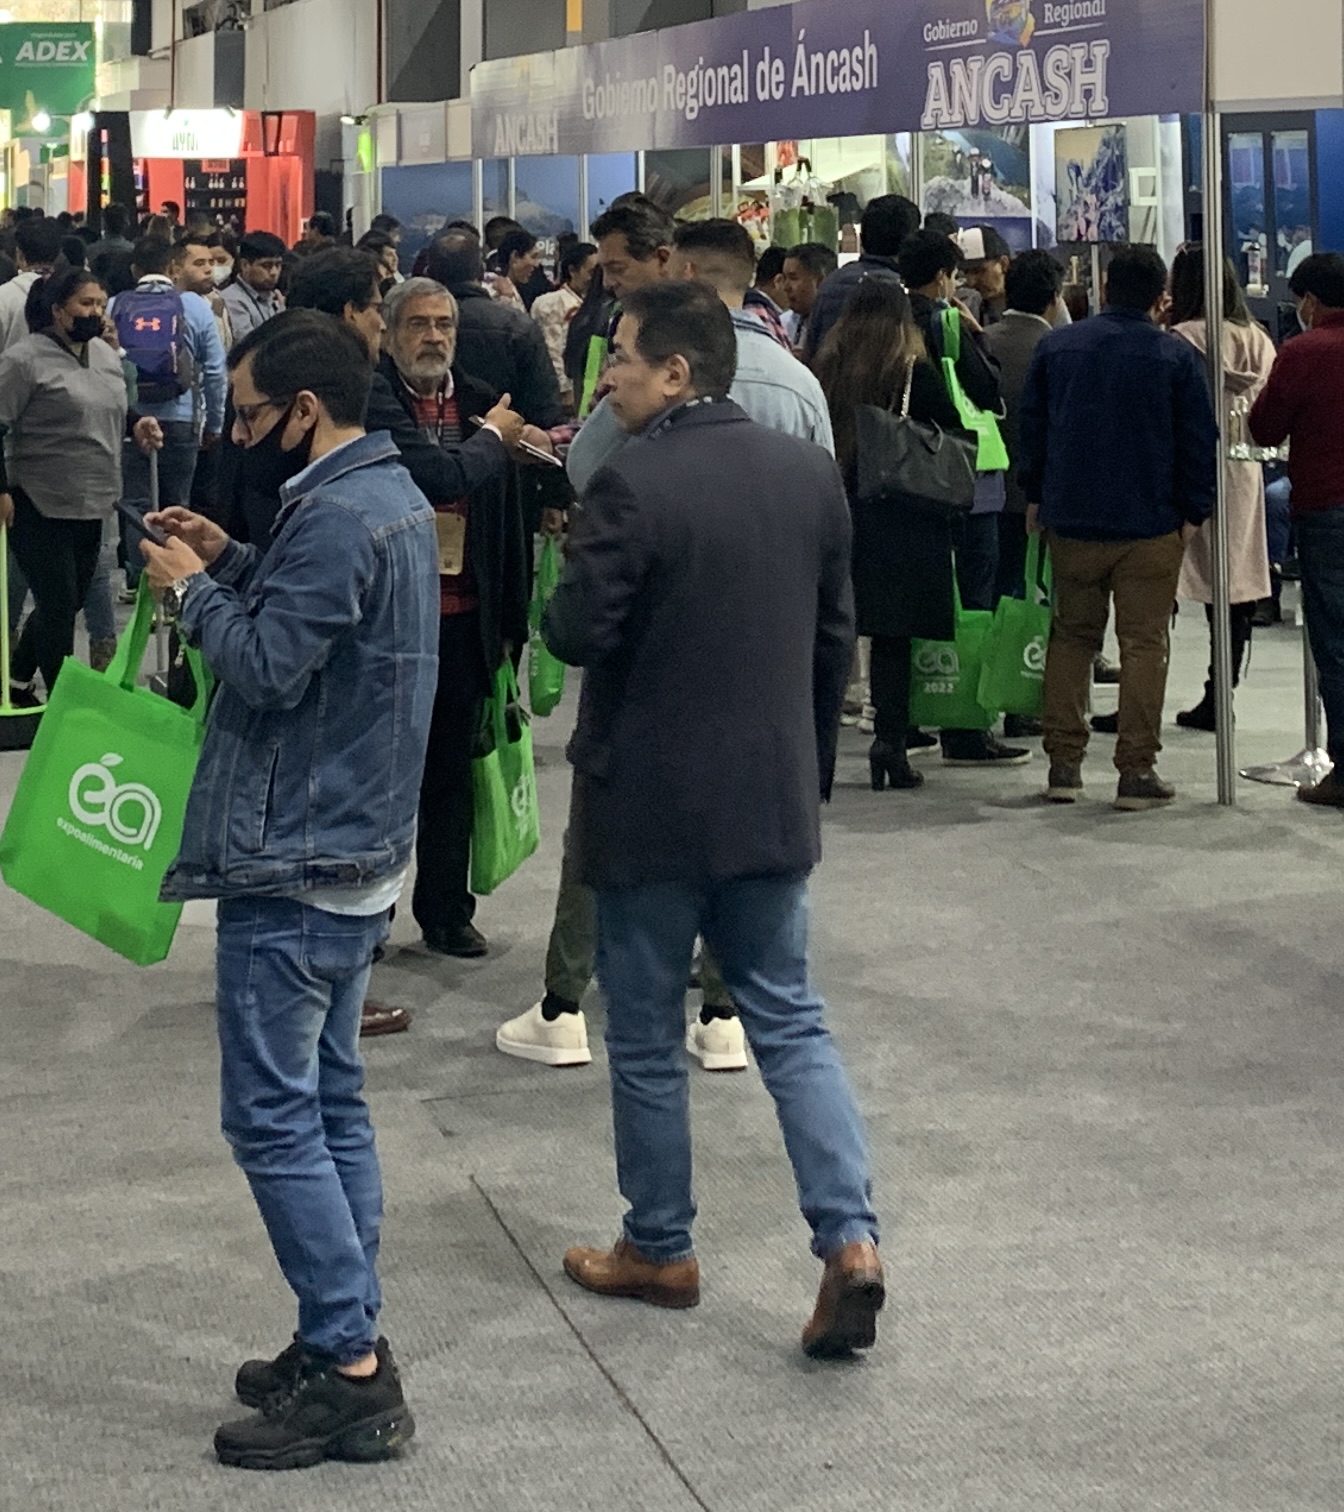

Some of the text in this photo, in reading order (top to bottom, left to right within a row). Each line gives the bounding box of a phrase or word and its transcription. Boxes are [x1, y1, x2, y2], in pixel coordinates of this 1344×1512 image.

[15, 40, 91, 62] ADEX
[924, 18, 978, 42] Gobierno
[582, 29, 878, 120] Gobierno Regional de Áncash
[921, 39, 1110, 129] ANCASH
[493, 114, 557, 156] ANCASH
[924, 682, 955, 694] 2022
[56, 817, 144, 870] expoalimentaria
